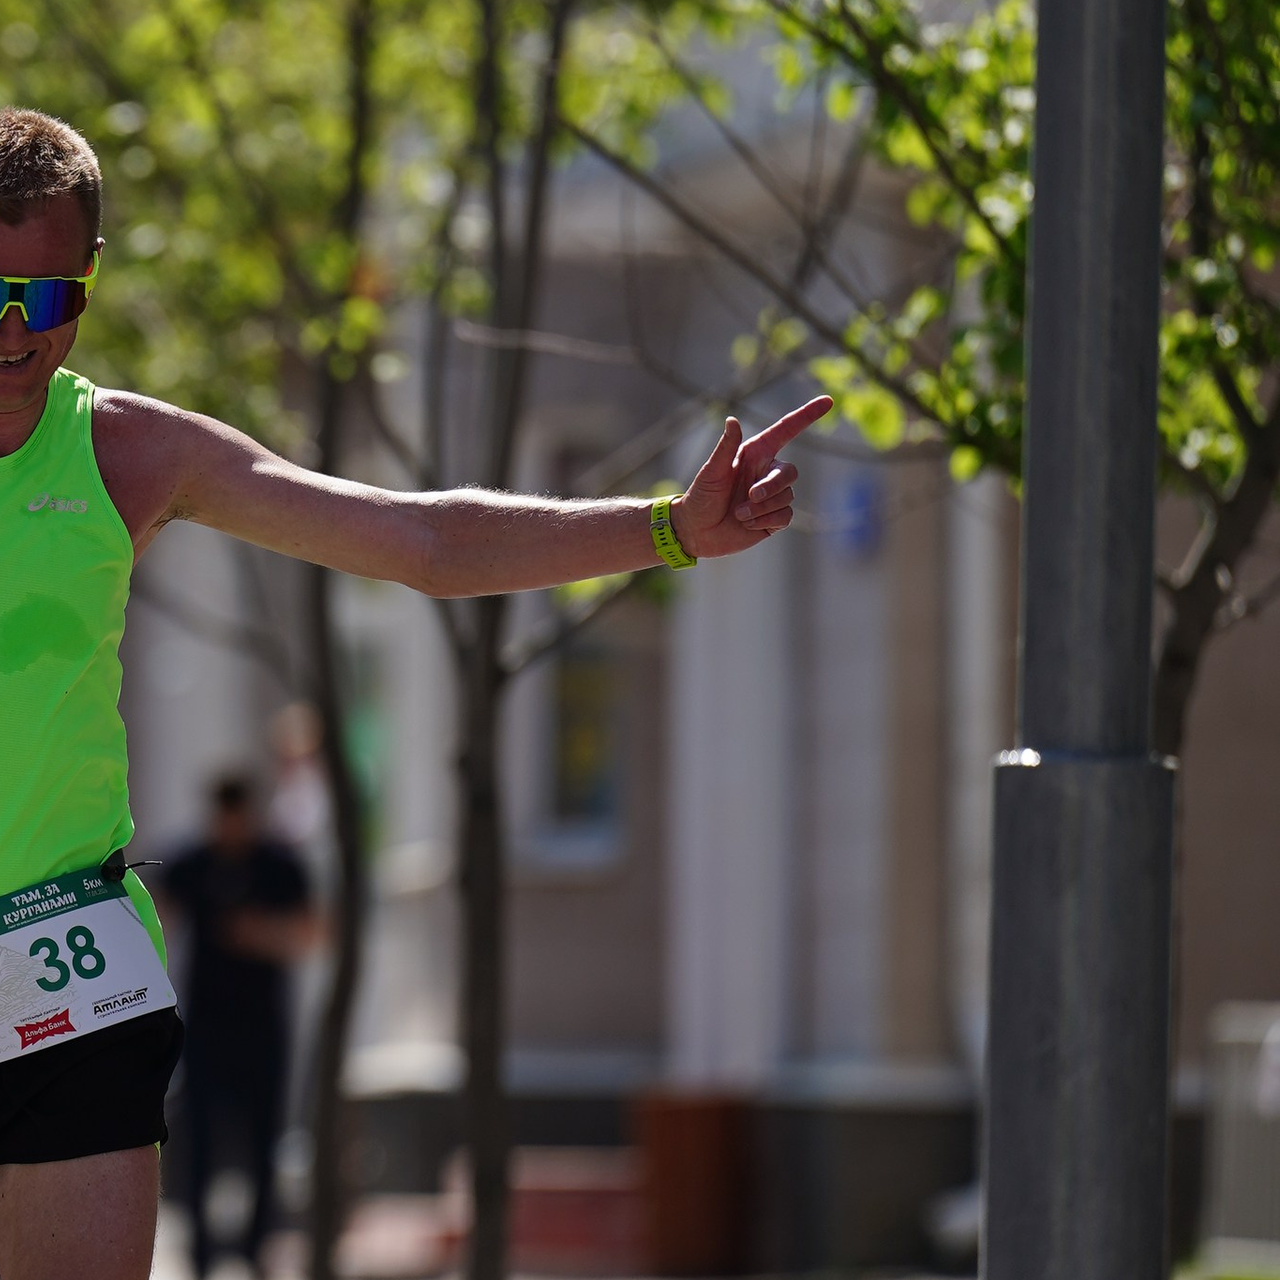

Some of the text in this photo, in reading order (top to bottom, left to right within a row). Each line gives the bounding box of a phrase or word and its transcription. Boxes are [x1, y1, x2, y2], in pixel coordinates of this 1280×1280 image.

[2, 891, 77, 926] КУРГАНАМИ
[11, 883, 61, 907] ТАМ, ЗА
[29, 925, 106, 992] 38
[24, 1019, 67, 1041] Альфа Банк
